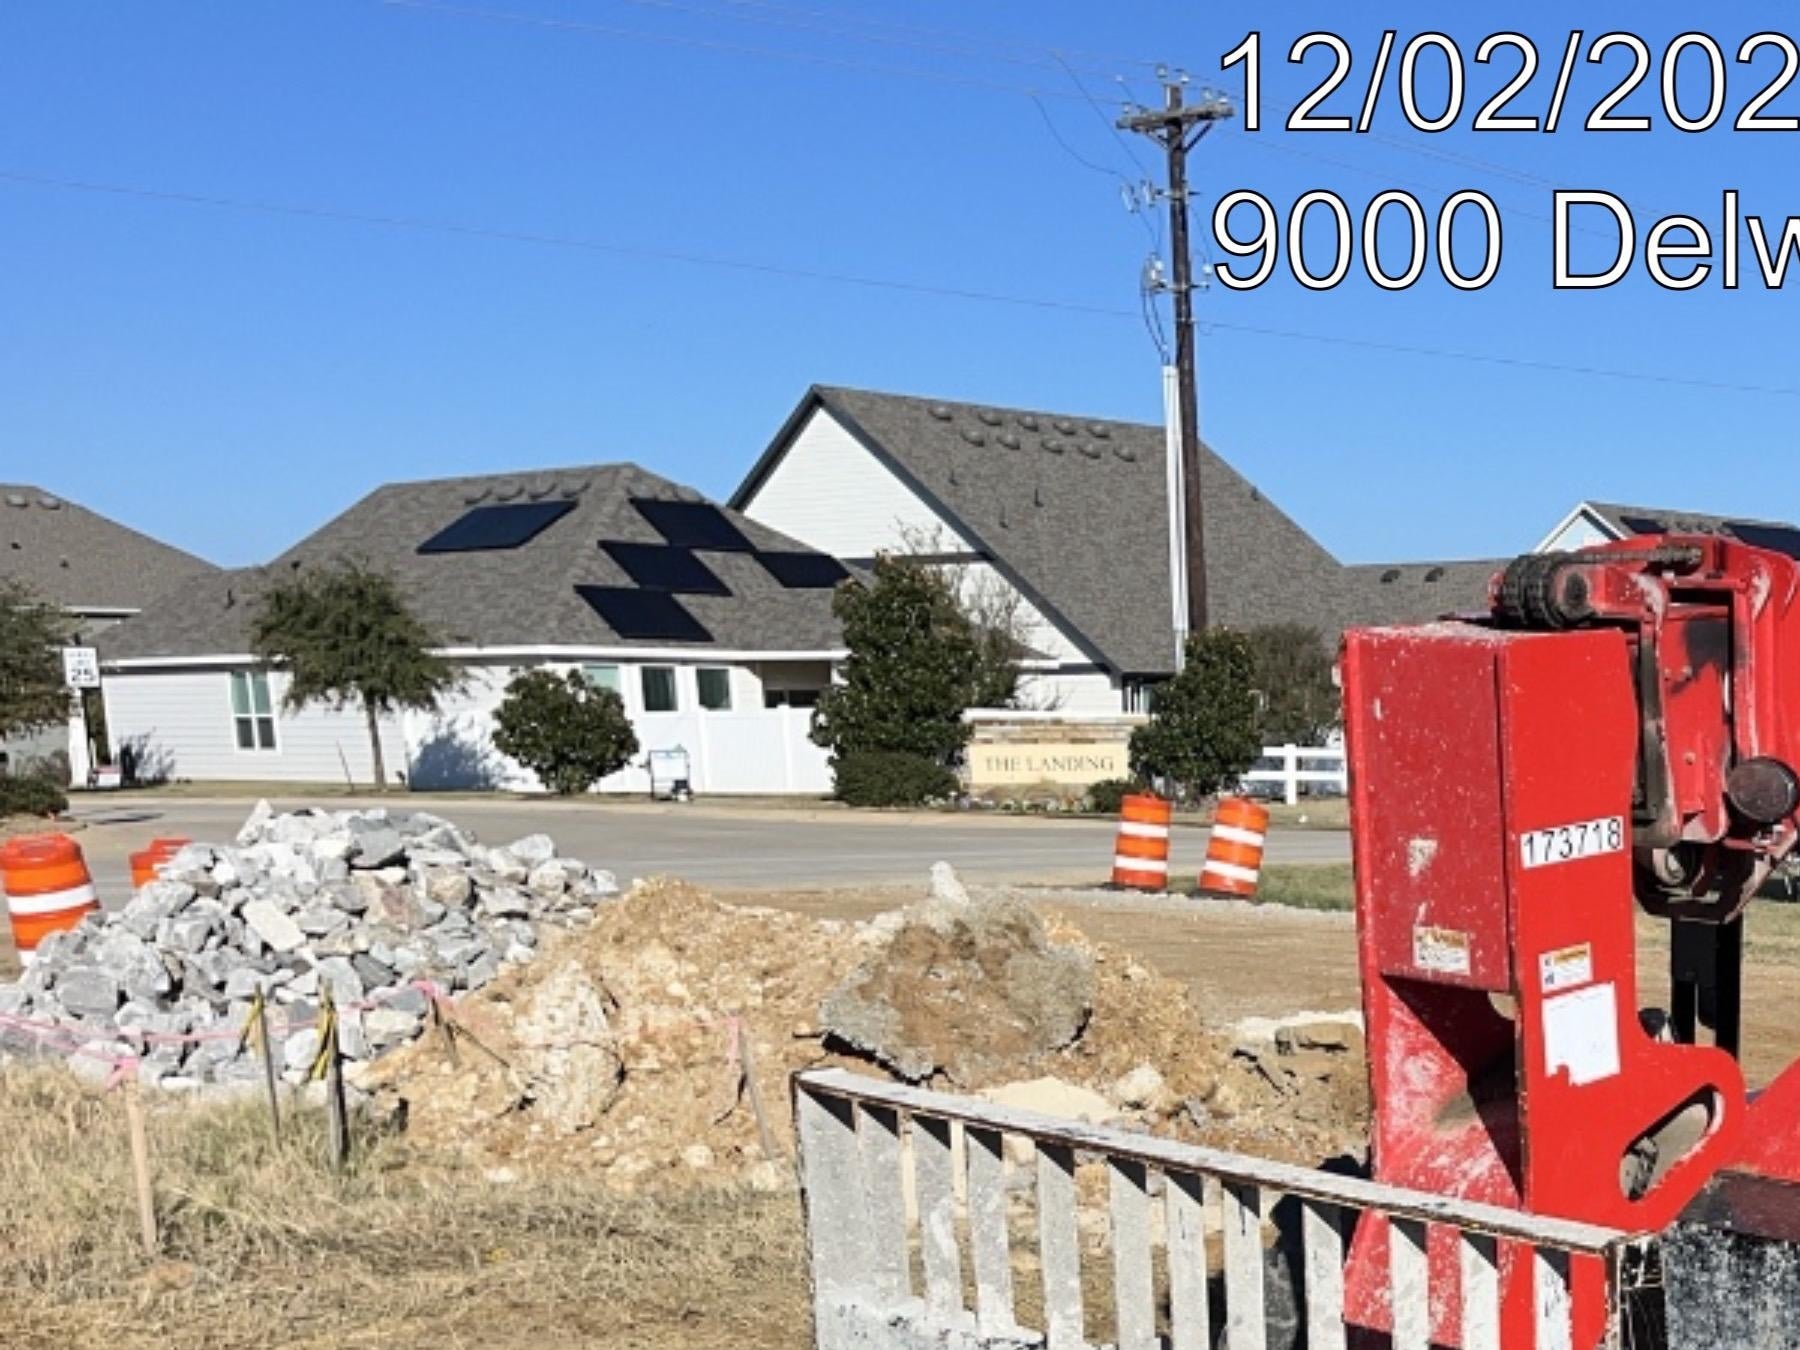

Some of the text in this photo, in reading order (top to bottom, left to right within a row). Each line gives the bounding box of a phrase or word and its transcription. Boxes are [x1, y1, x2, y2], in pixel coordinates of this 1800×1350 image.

[985, 755, 1116, 772] THE LANDING
[1523, 818, 1621, 865] 173718
